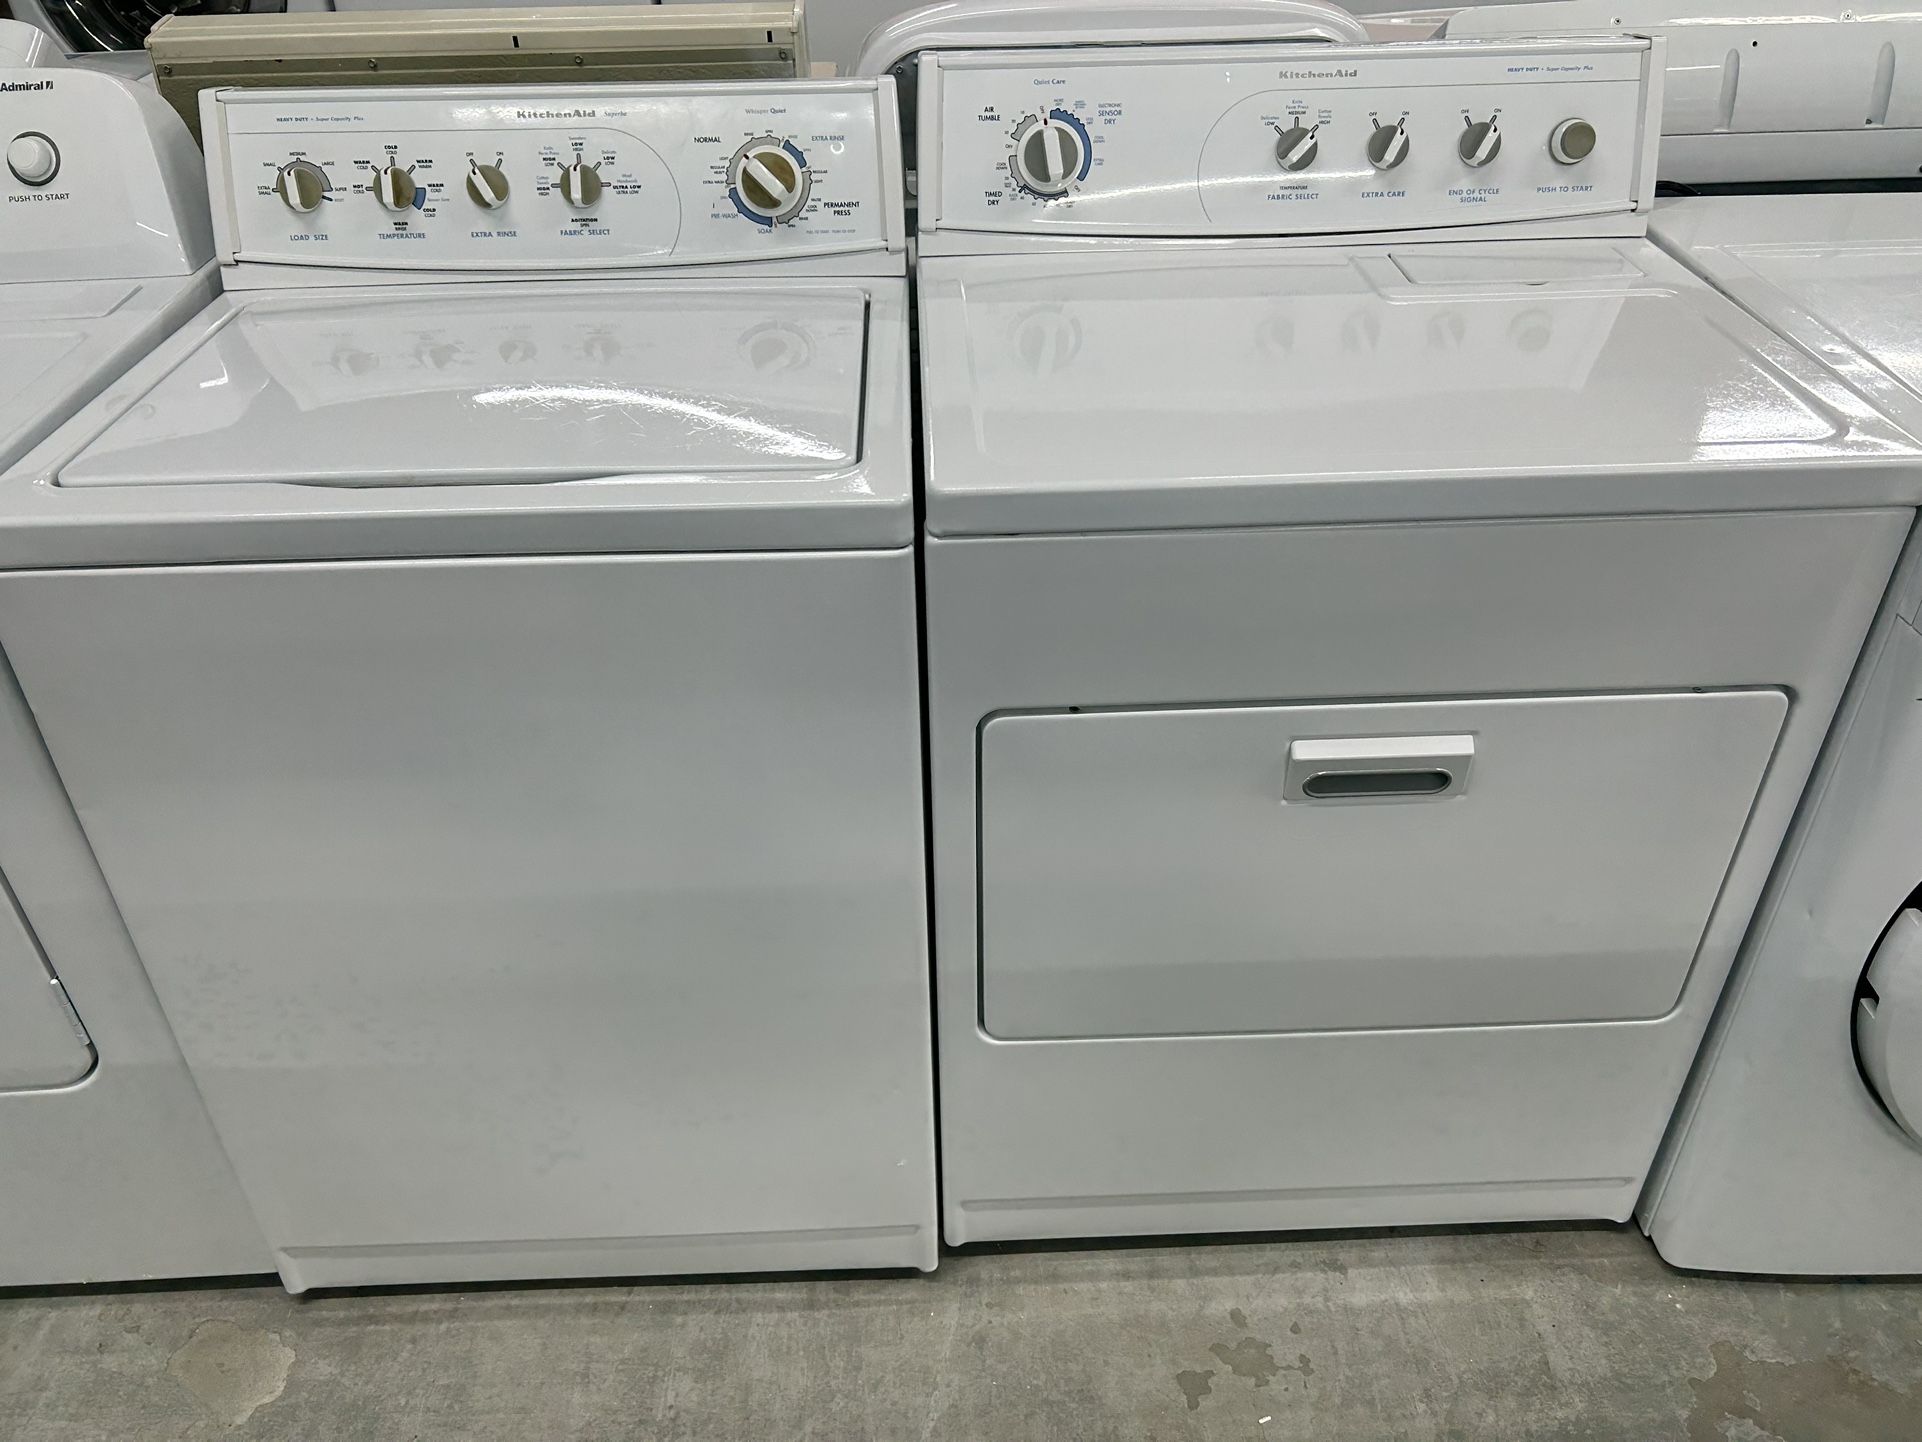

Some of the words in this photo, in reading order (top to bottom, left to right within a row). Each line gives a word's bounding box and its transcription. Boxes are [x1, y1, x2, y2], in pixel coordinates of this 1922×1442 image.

[1279, 69, 1357, 79] KitchenAid
[0, 81, 43, 92] Admiral
[516, 110, 596, 119] KitchenAid
